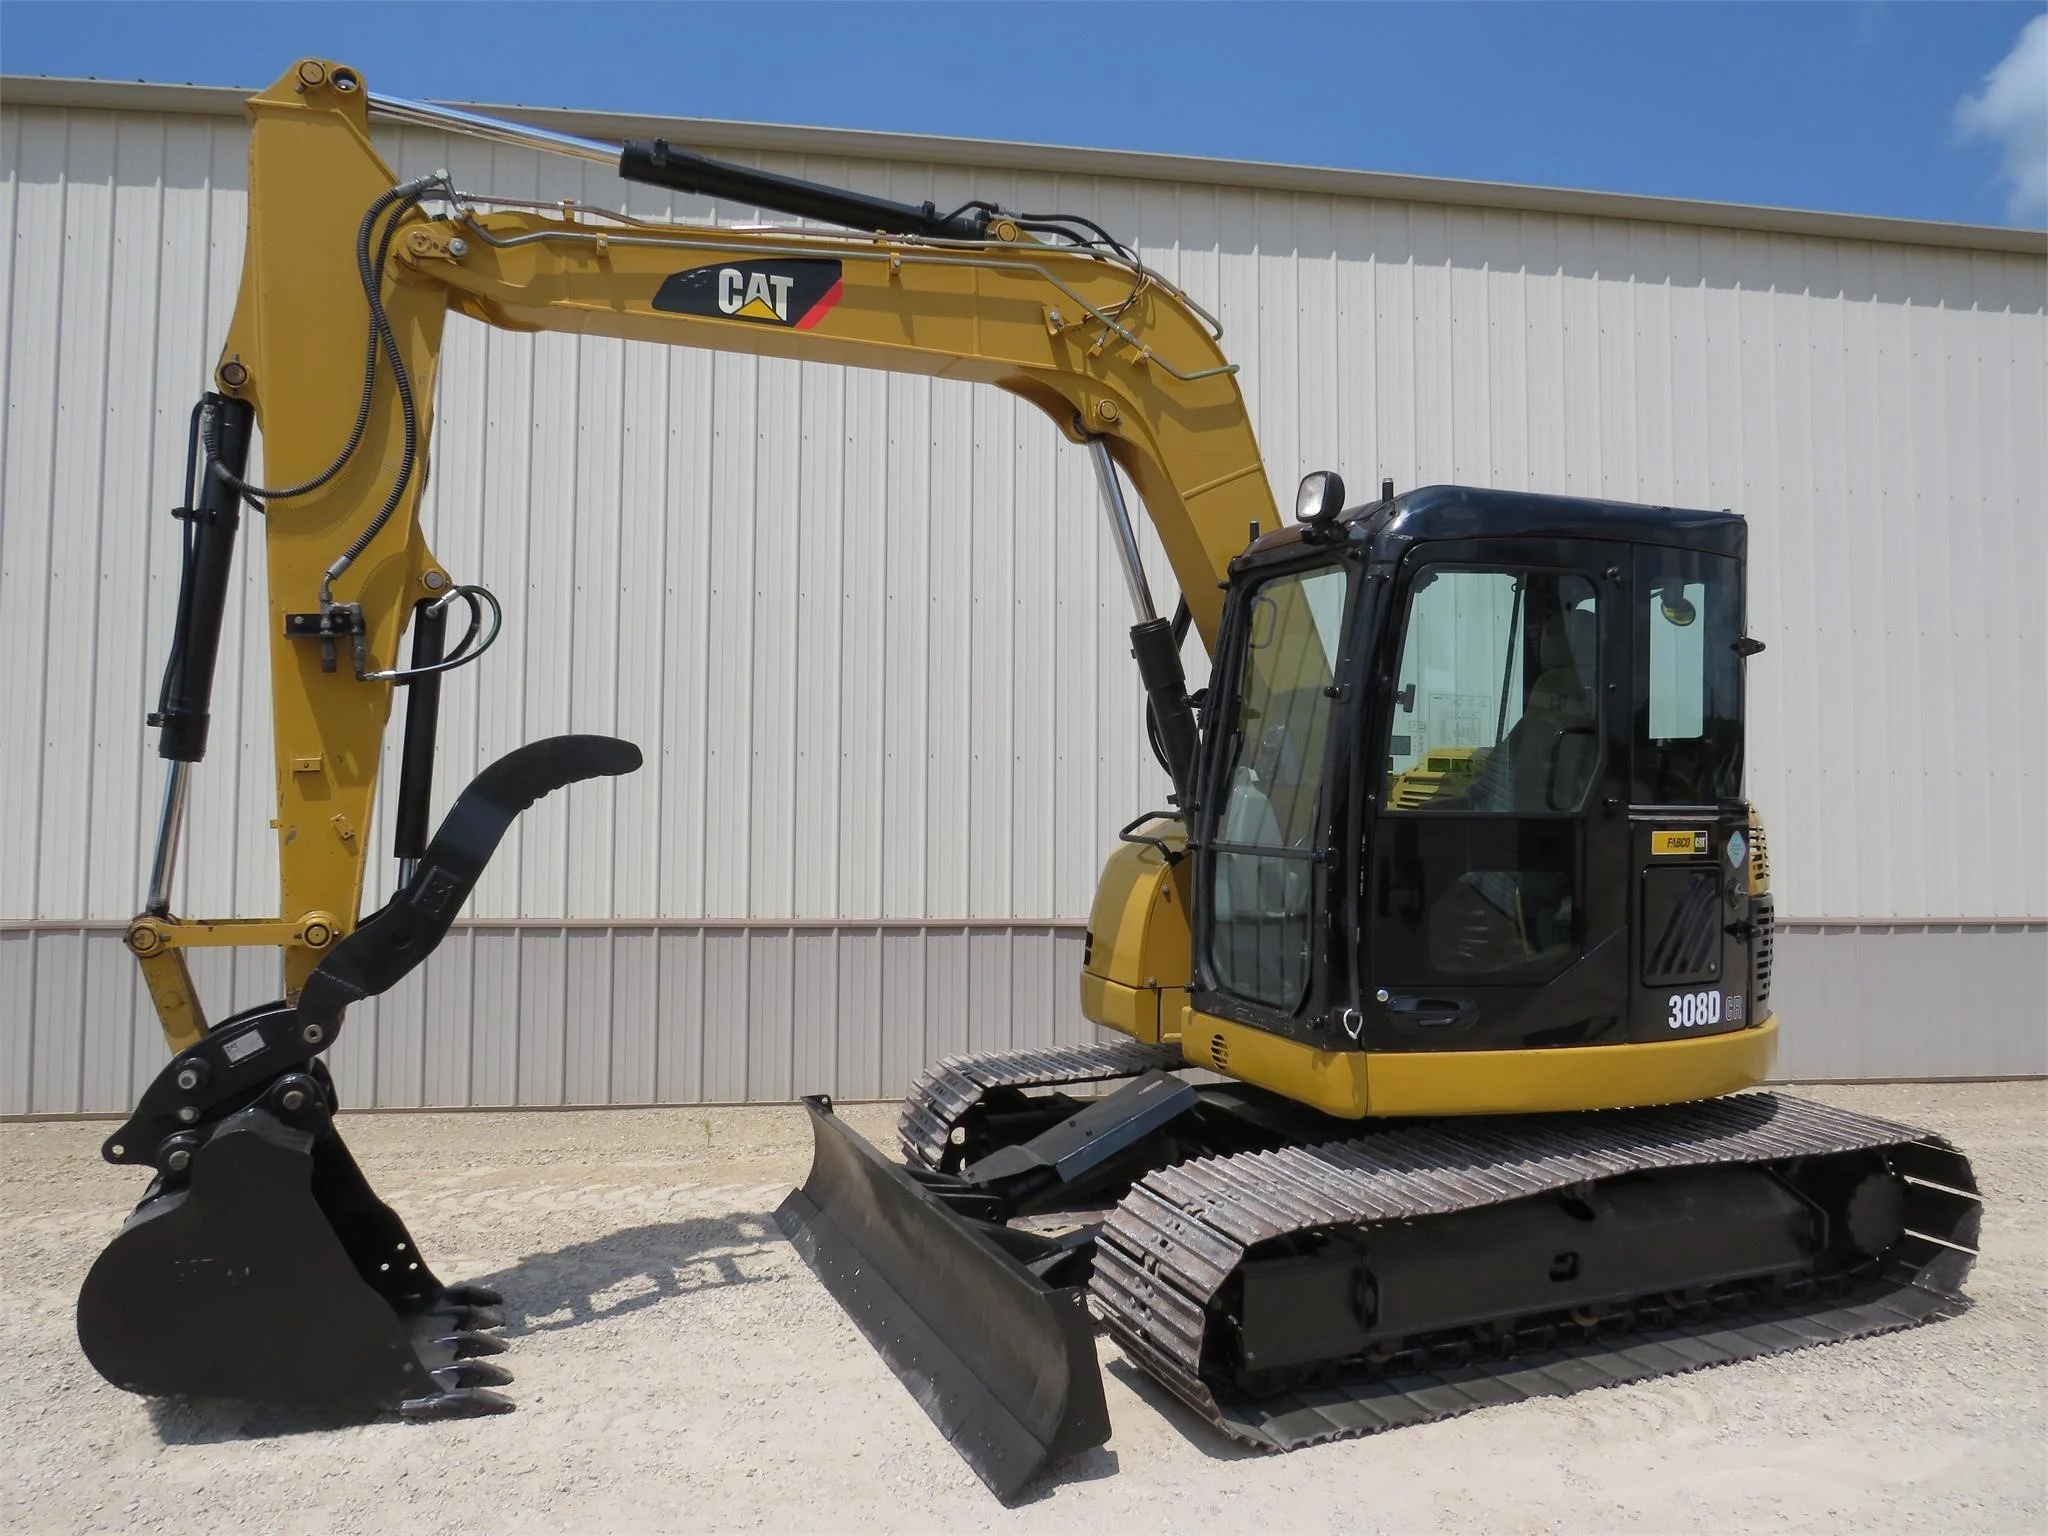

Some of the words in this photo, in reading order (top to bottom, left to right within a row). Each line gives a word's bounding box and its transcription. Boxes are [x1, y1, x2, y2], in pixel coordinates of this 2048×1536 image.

[718, 268, 794, 321] CAT
[1666, 837, 1691, 849] FABCO
[1668, 990, 1720, 1029] 308D
[1725, 995, 1742, 1021] CR
